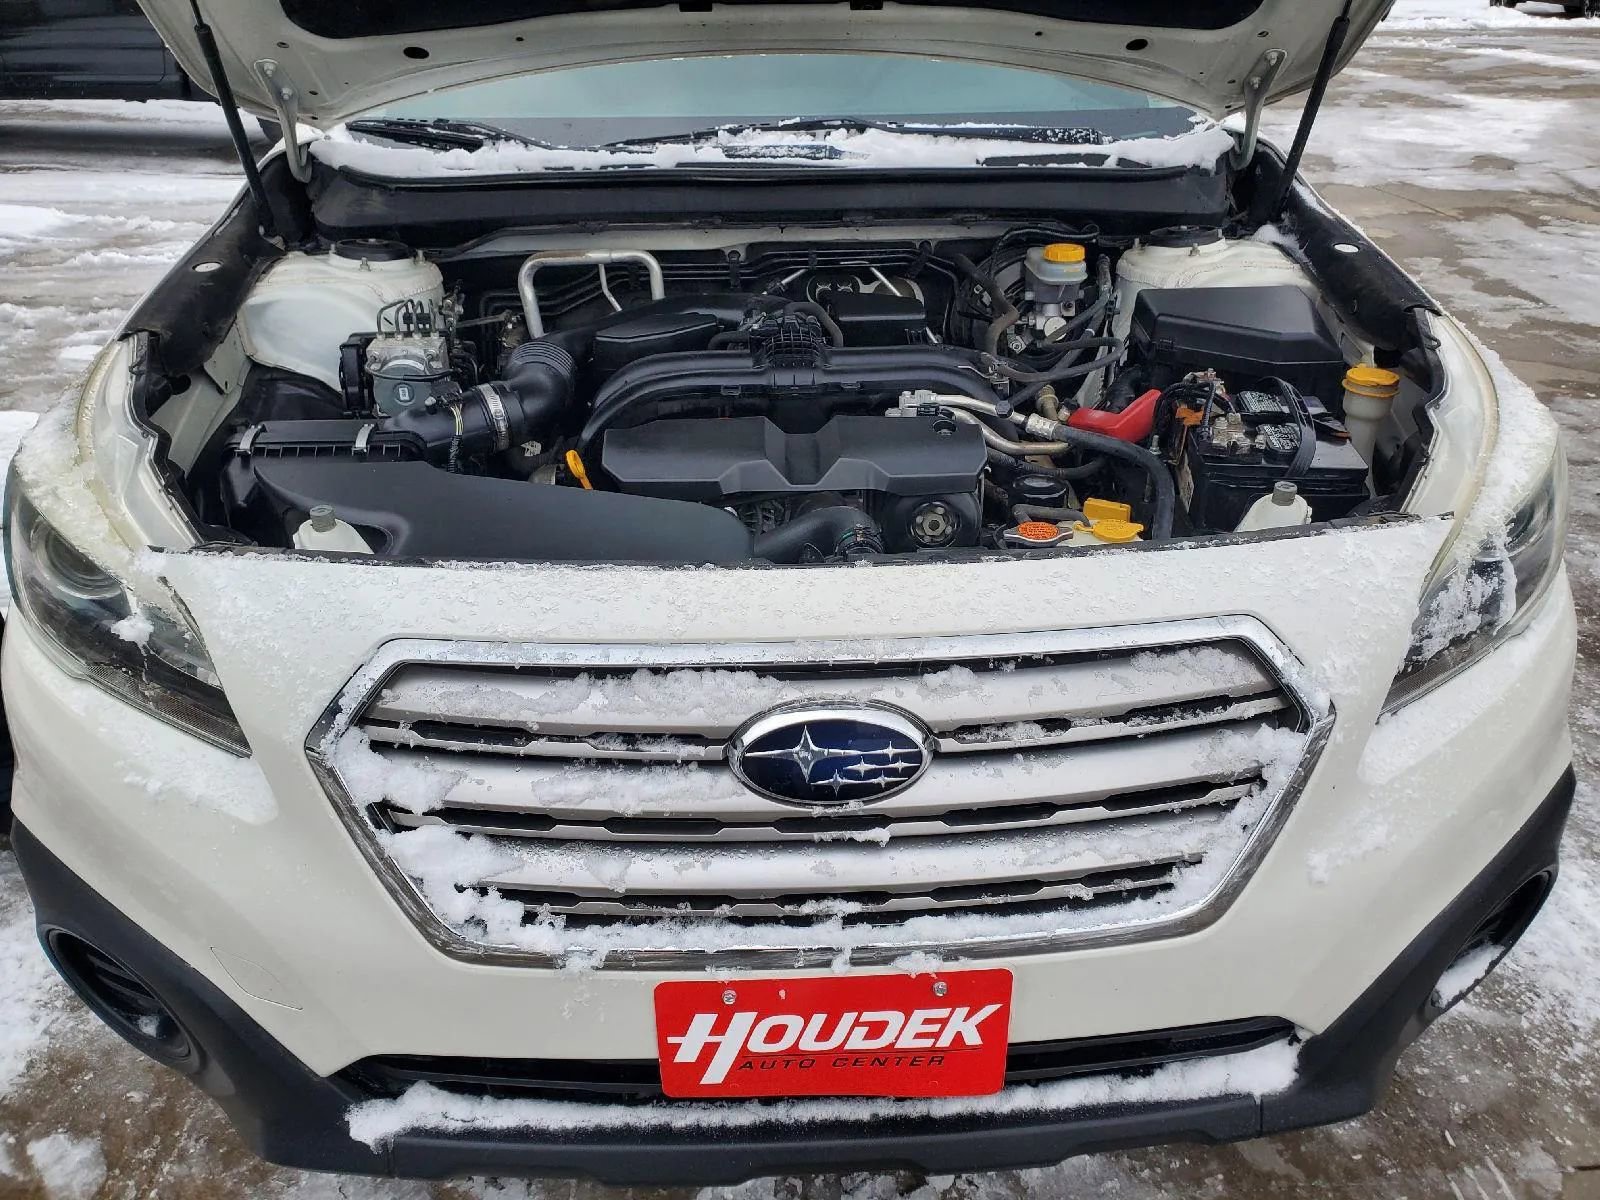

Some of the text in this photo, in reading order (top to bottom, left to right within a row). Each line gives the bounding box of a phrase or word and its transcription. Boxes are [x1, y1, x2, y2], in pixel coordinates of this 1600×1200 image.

[667, 1004, 1003, 1084] HOUDEK
[737, 1055, 945, 1071] AUTO CENTER
